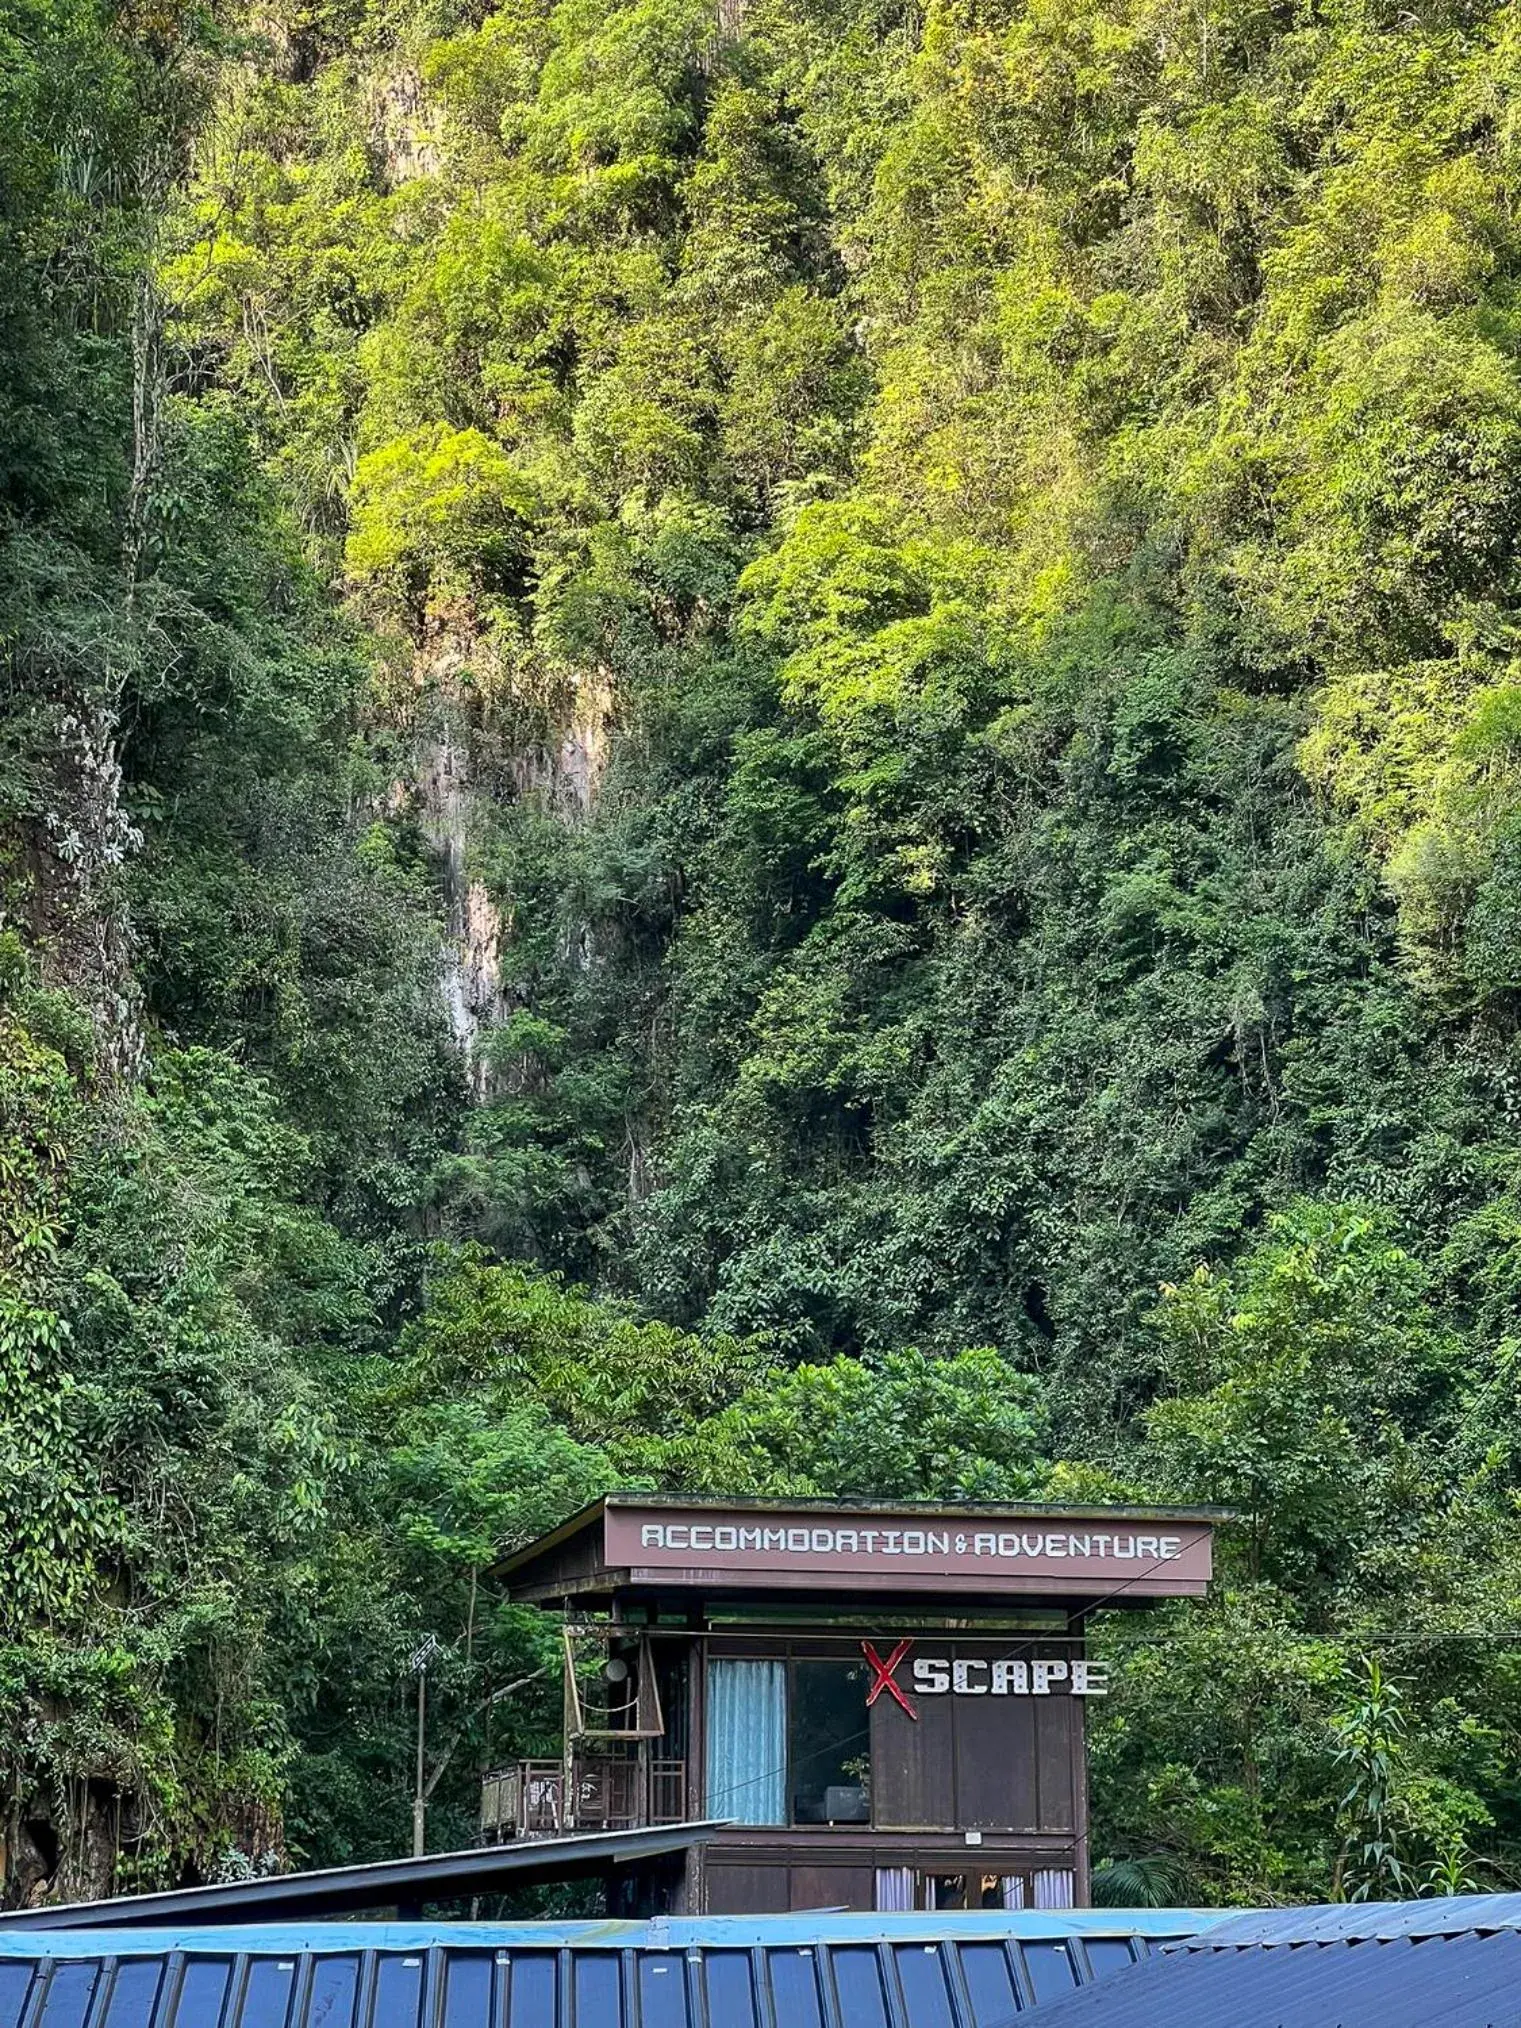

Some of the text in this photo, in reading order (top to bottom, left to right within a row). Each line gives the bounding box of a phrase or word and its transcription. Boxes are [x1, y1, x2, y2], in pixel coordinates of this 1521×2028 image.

[641, 1524, 1181, 1560] ACCOMMODATION & ADVENTURE
